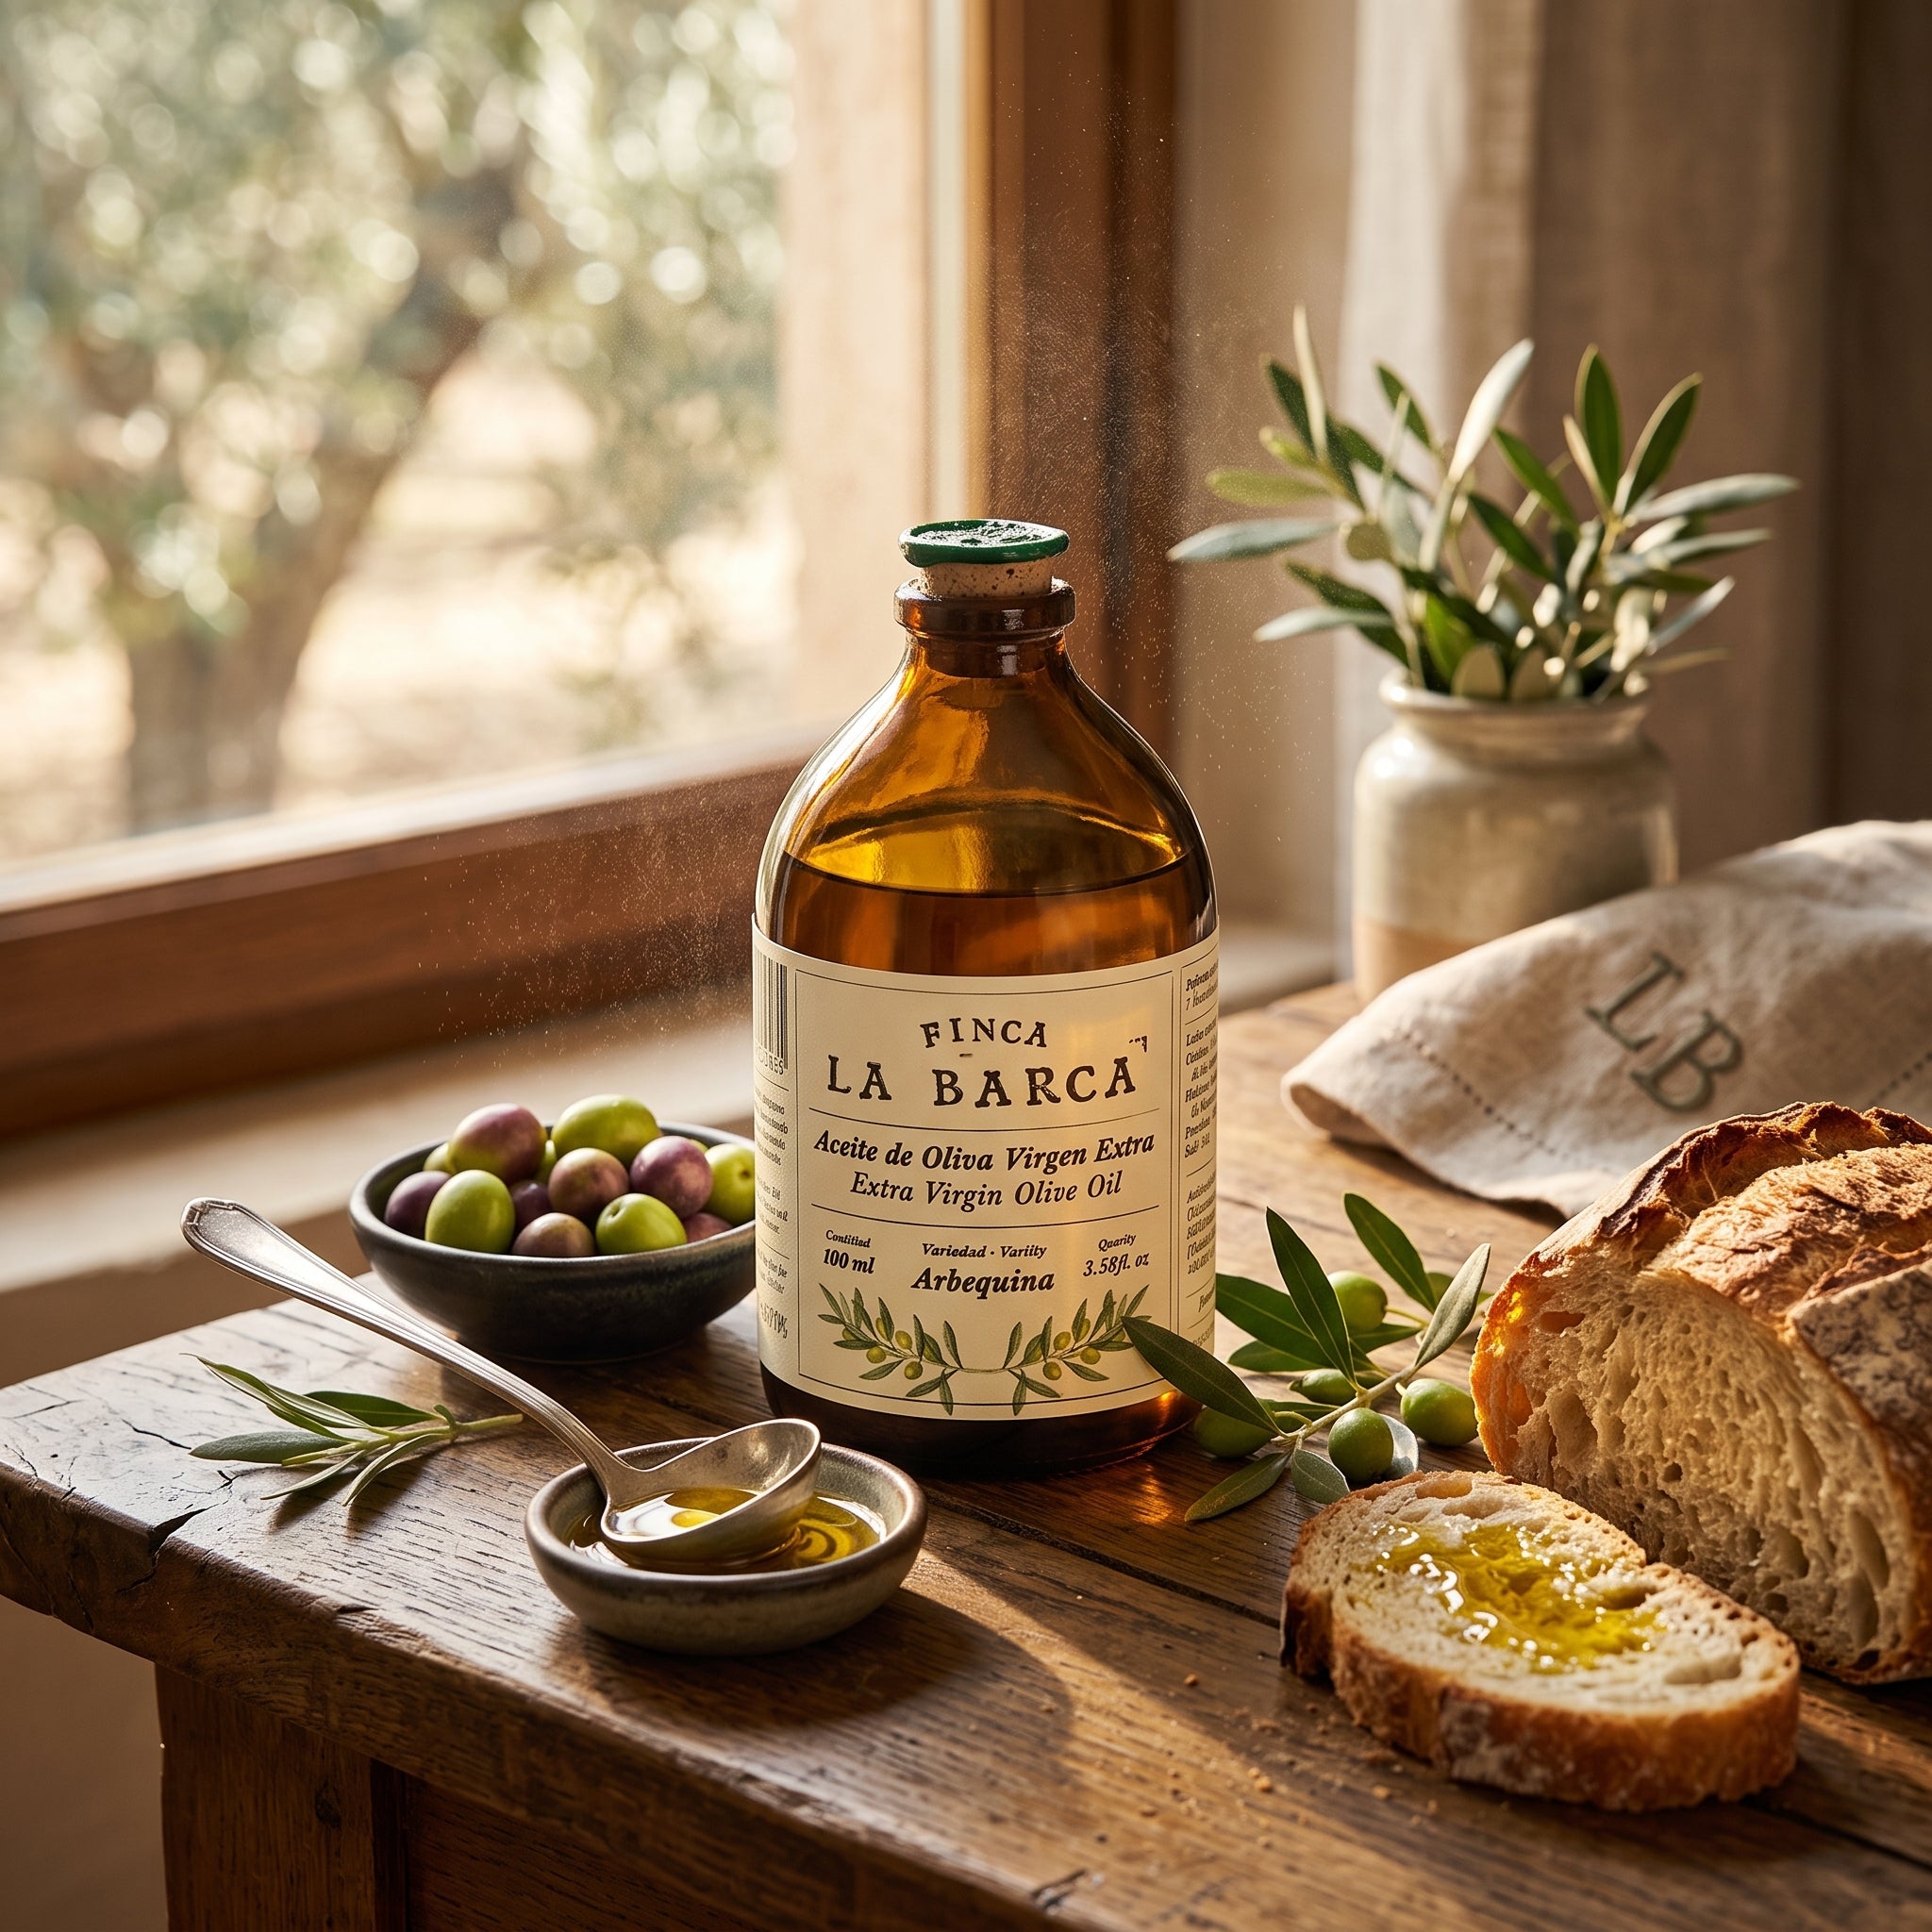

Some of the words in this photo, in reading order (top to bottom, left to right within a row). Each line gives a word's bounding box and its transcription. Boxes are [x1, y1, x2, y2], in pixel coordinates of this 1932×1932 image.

[920, 1017, 1047, 1048] FINCA
[1584, 952, 1742, 1114] LB
[827, 1054, 892, 1101] LA
[931, 1056, 1136, 1108] BARCA
[813, 1129, 878, 1161] Aceite
[885, 1142, 913, 1167] de
[922, 1145, 993, 1171] Oliva
[1006, 1145, 1088, 1175] Virgen
[1093, 1134, 1155, 1163] Extra
[850, 1171, 914, 1202] Extra
[925, 1180, 1003, 1213] Virgin
[1014, 1180, 1078, 1205] Olive
[1087, 1170, 1124, 1197] Oil
[823, 1248, 850, 1270] 100
[852, 1257, 876, 1274] ml
[922, 1242, 987, 1258] Variedad
[1135, 1253, 1150, 1268] oz
[909, 1267, 1056, 1300] Arbequina
